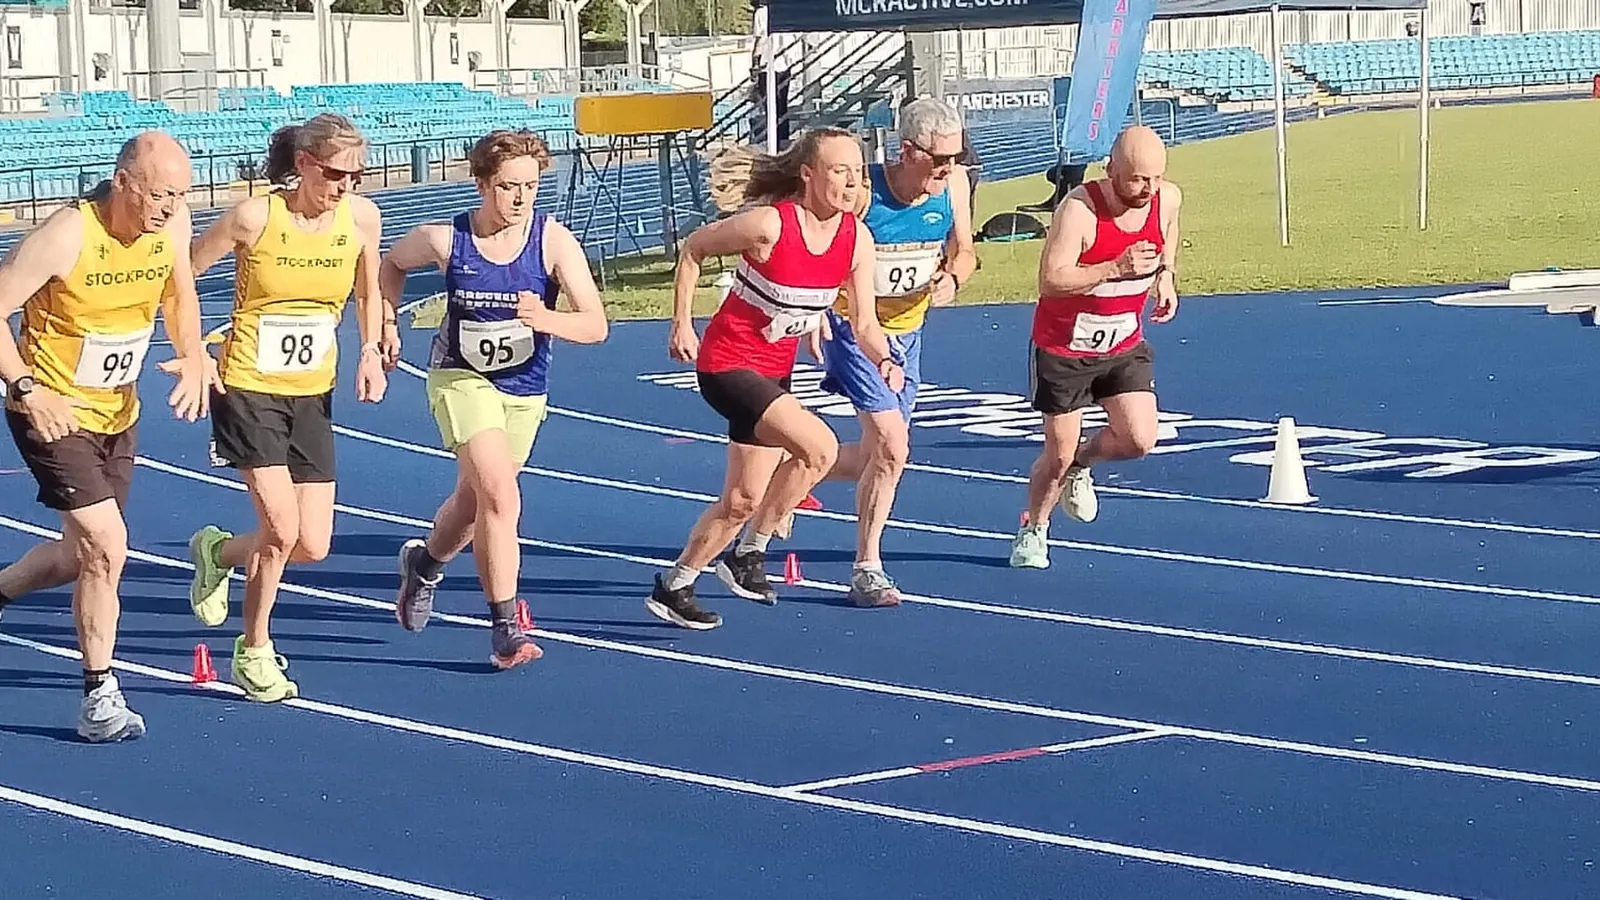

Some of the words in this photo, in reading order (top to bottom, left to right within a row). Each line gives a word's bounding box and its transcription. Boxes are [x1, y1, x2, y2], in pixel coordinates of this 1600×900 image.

[836, 0, 1028, 16] MCRACTI.
[276, 256, 344, 269] STOCKPORT
[889, 266, 918, 293] 93
[281, 333, 313, 366] 98
[479, 335, 515, 366] 95
[1091, 328, 1118, 349] 91
[102, 350, 133, 383] 99
[635, 363, 1600, 479] CHESTER
